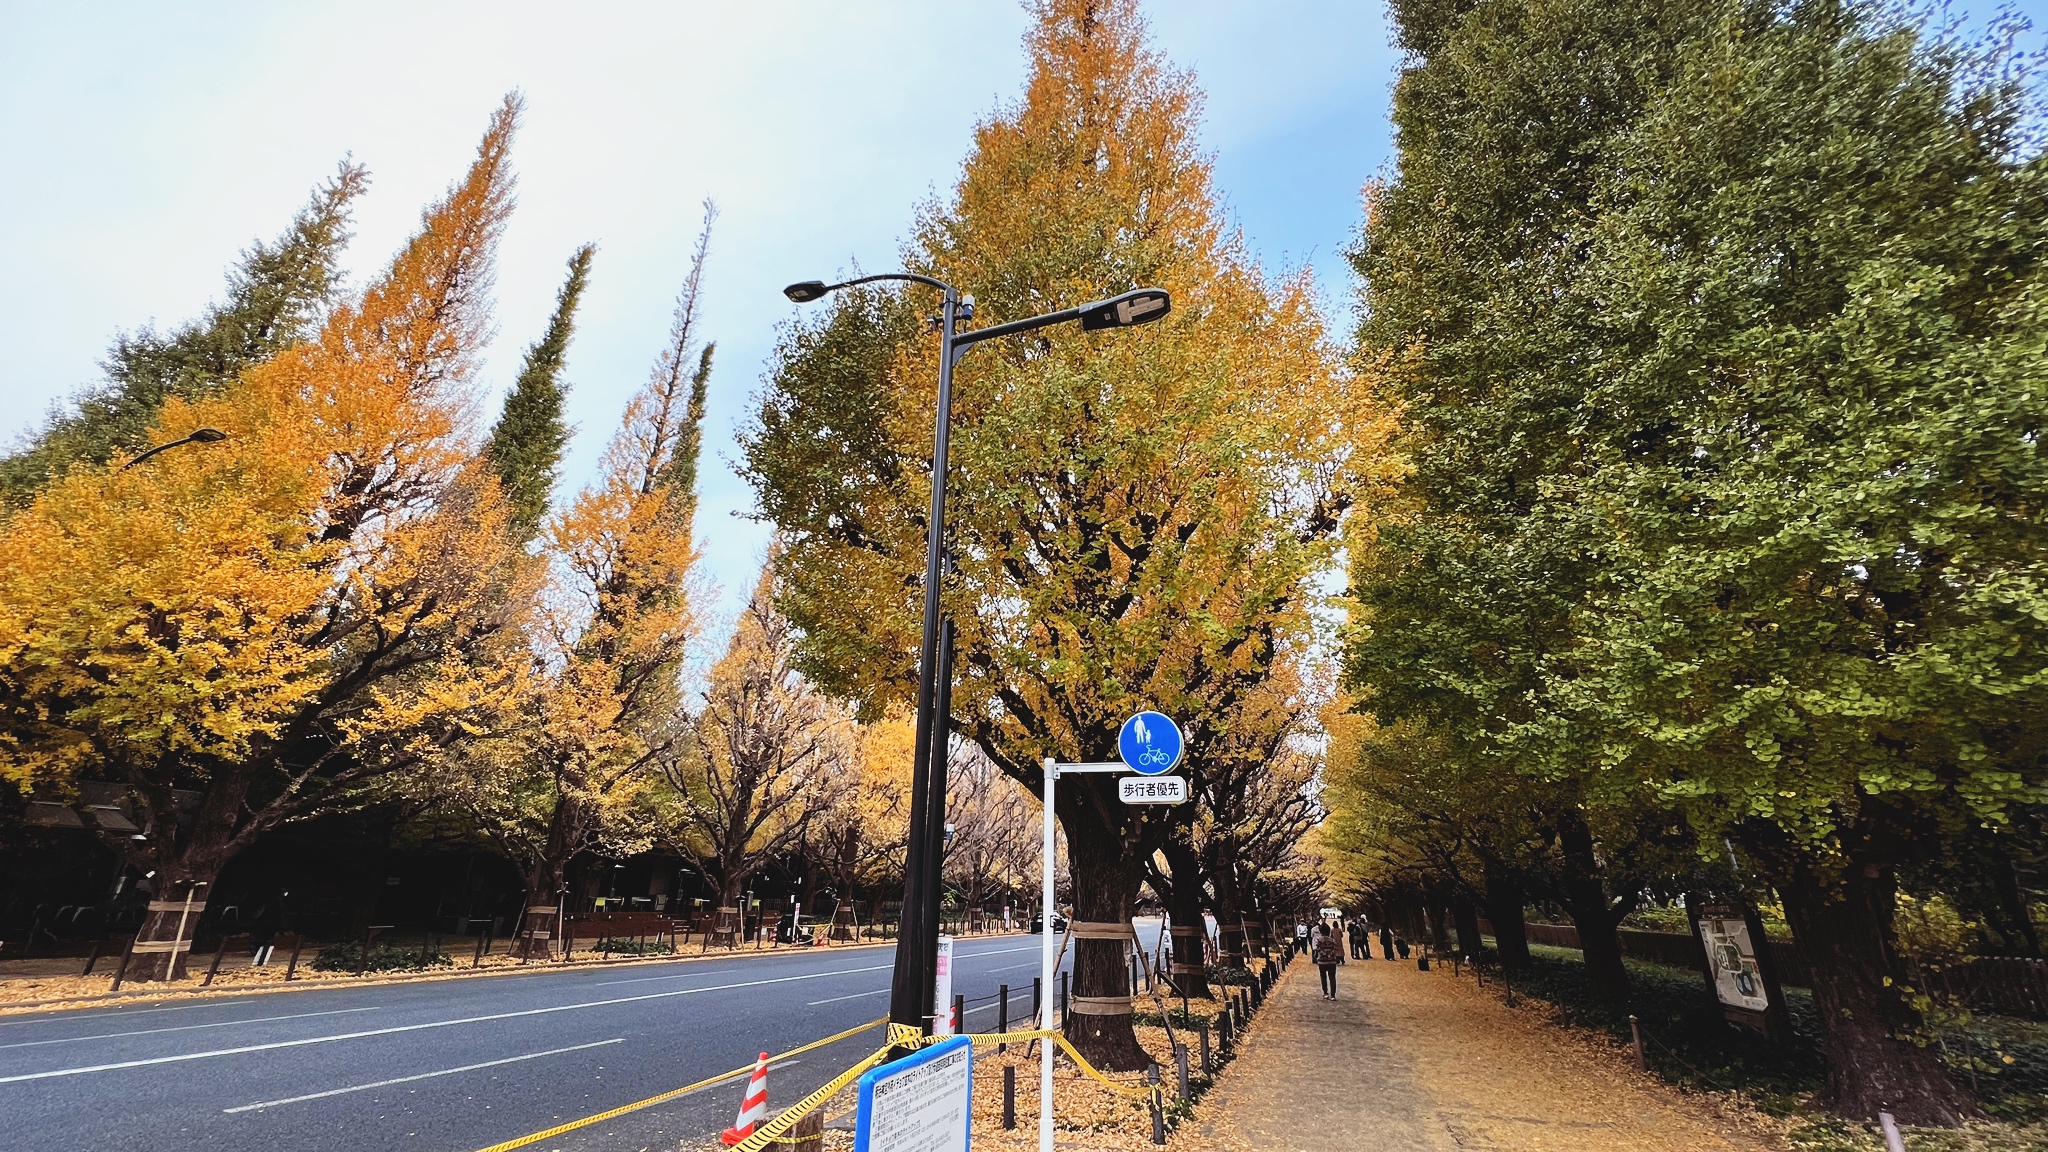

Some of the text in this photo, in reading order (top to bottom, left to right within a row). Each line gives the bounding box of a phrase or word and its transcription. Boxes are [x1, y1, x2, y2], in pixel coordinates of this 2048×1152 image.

[1123, 782, 1179, 797] 歩行者優先
